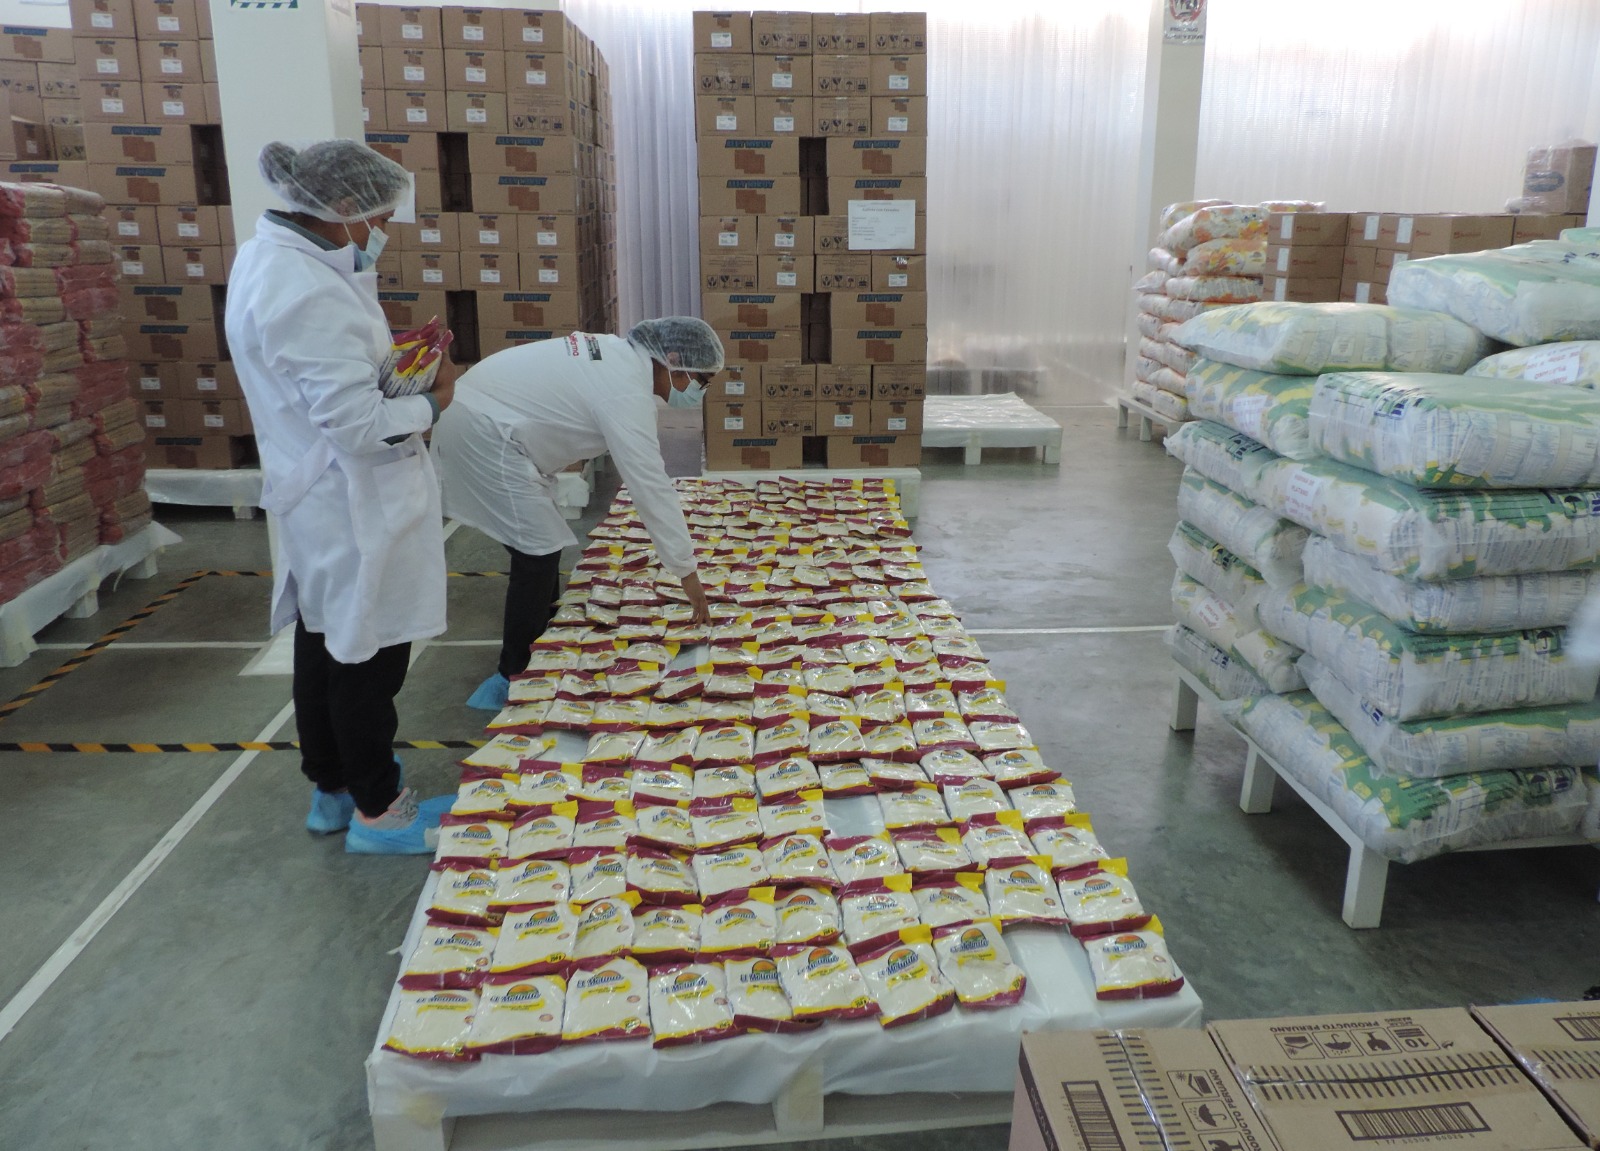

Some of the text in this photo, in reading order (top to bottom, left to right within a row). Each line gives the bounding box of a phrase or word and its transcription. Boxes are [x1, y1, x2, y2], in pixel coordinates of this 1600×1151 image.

[1270, 1021, 1379, 1033] PRODUCTO PERUANO
[1404, 1038, 1429, 1049] 10
[1209, 1069, 1236, 1109] PERUANO
